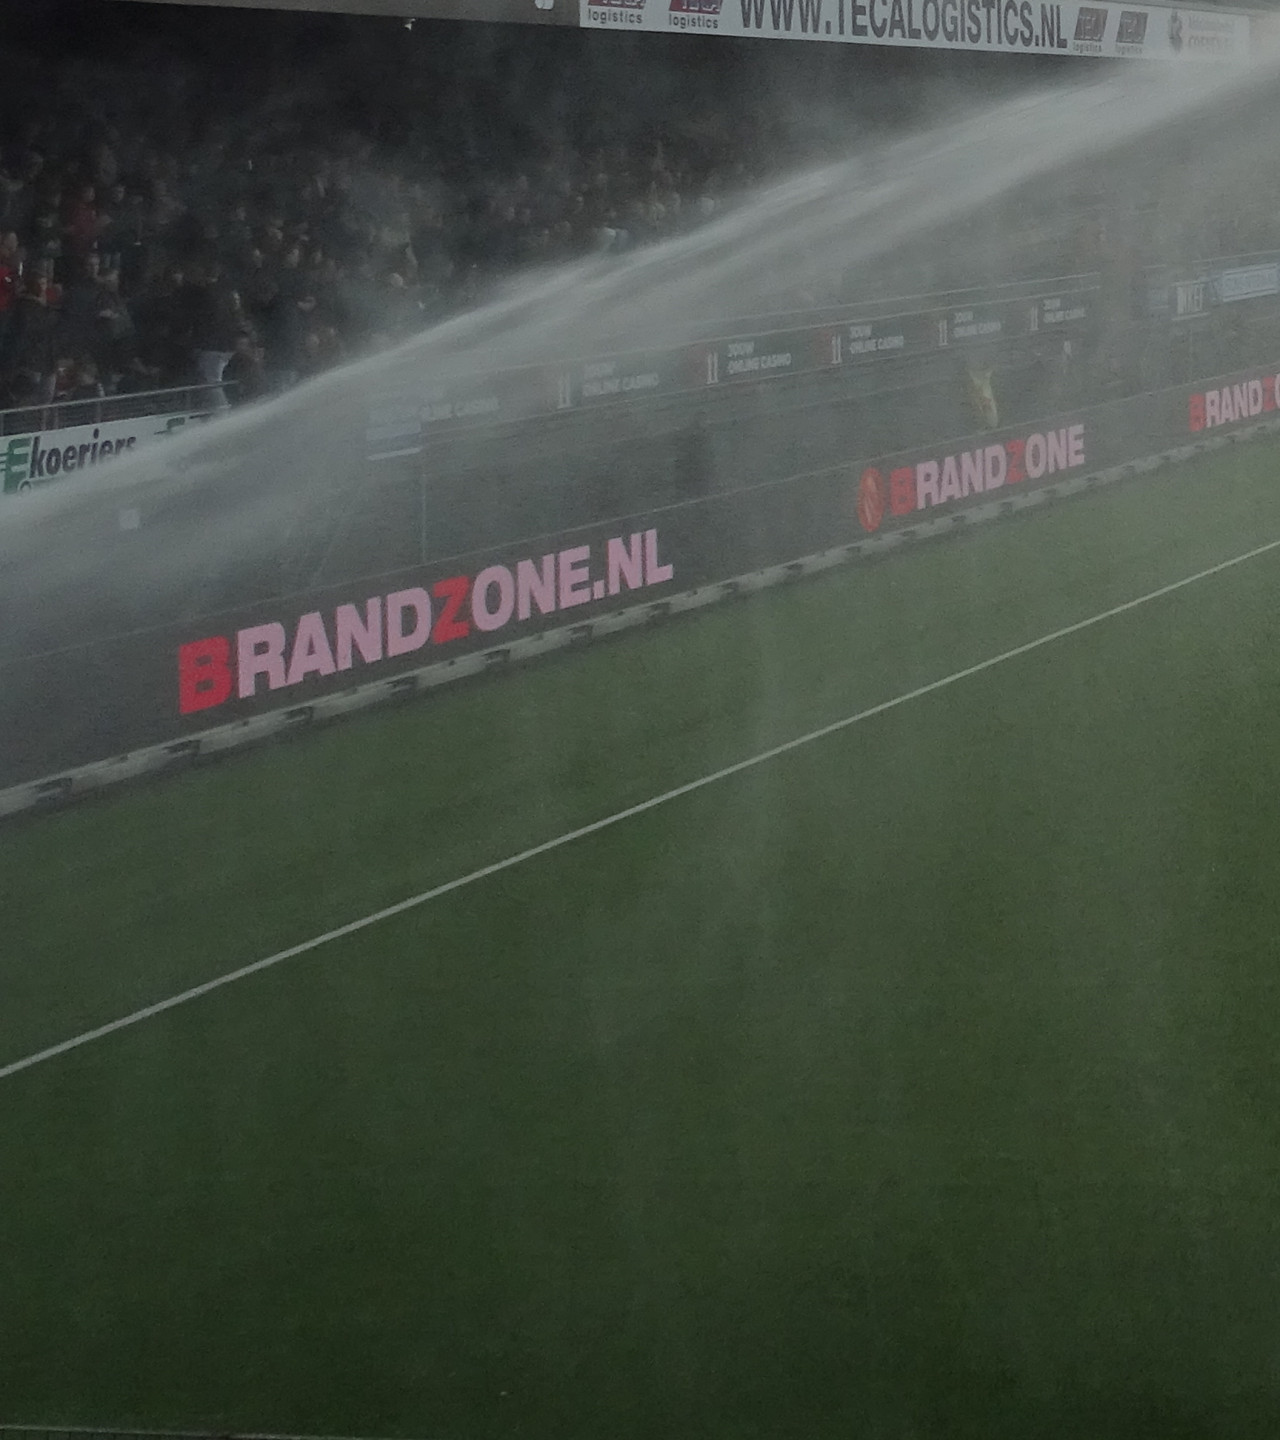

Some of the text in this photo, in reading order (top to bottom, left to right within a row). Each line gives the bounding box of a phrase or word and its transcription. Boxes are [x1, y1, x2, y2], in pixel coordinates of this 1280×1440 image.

[588, 9, 643, 24] logistics
[669, 14, 719, 29] logistics
[889, 422, 1087, 516] BRANDZONE
[178, 528, 674, 716] BRANDZONE.NL
